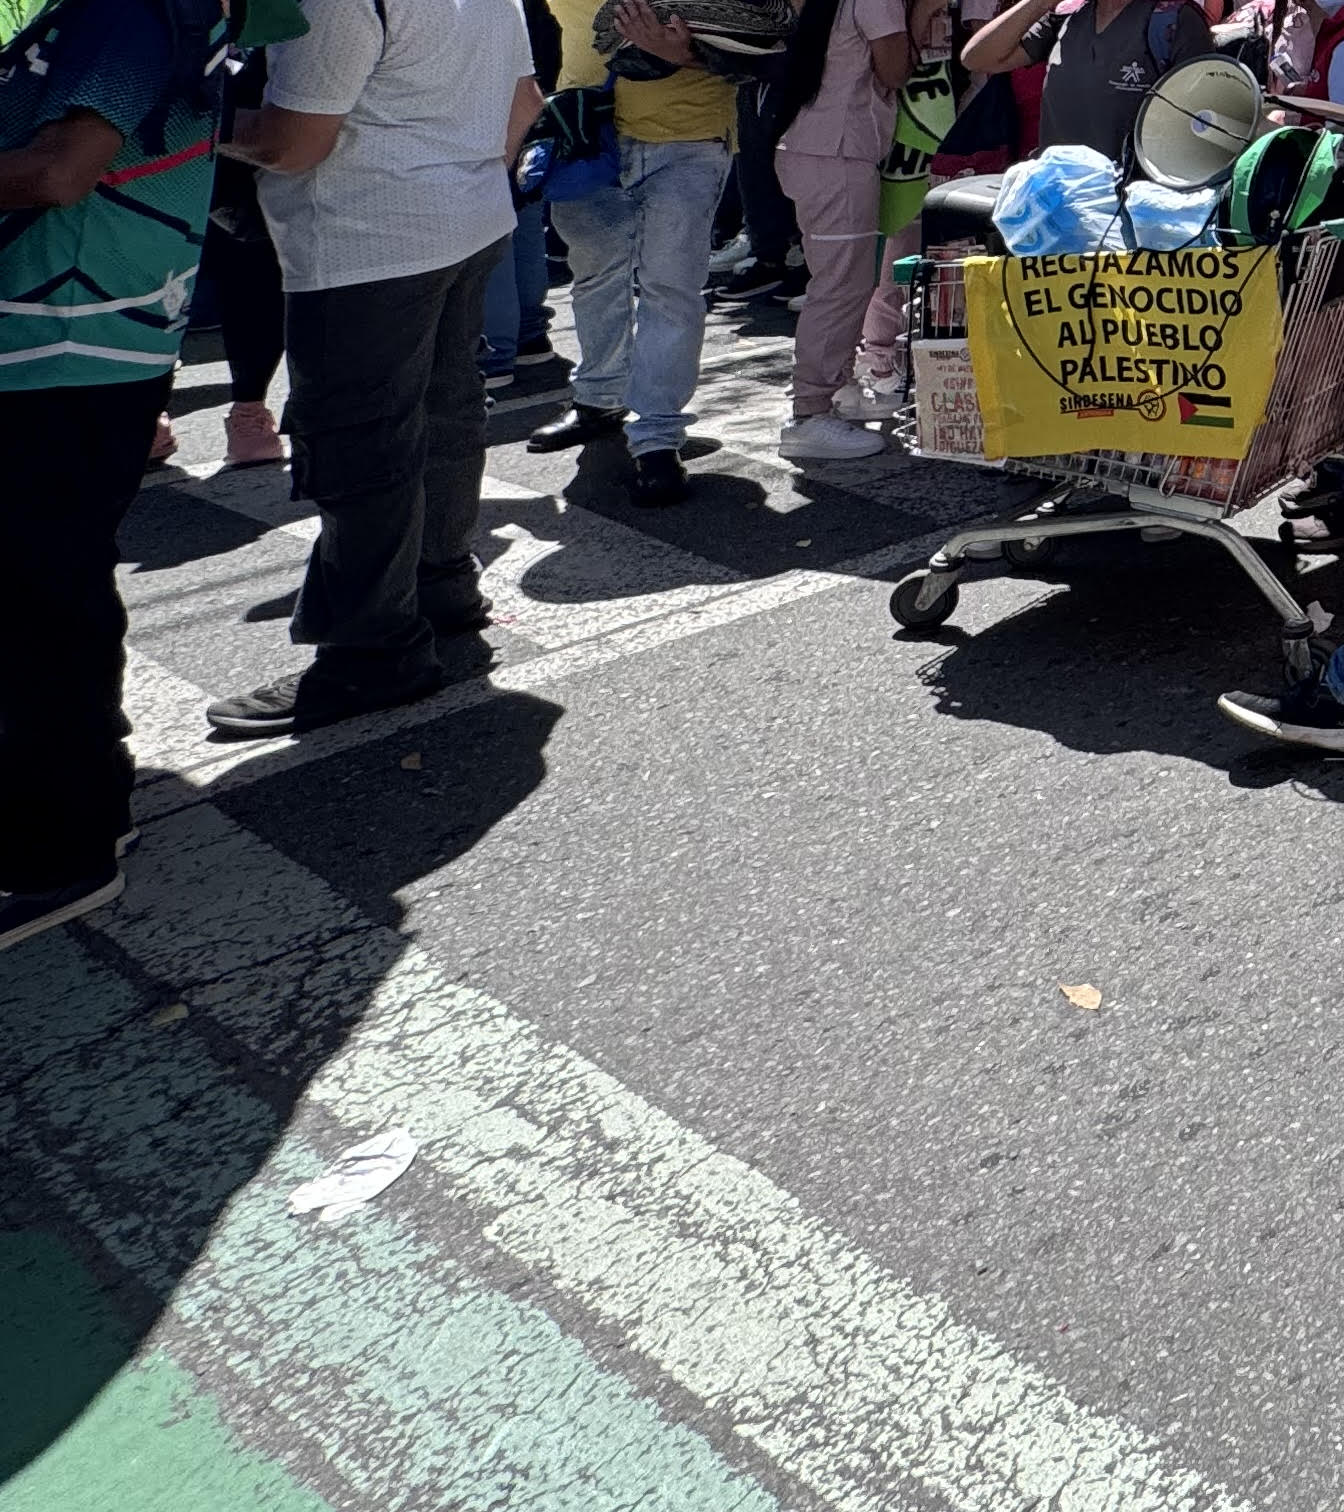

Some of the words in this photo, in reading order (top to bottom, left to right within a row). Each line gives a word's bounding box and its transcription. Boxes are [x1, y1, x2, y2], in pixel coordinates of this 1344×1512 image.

[1020, 250, 1241, 281] RECHAZAMOS
[1023, 288, 1062, 318] EL
[1067, 281, 1244, 317] GENOCIDIO
[1056, 318, 1096, 349] AL
[1101, 317, 1224, 352] PUEBLO
[1059, 354, 1228, 391] PALESTINO
